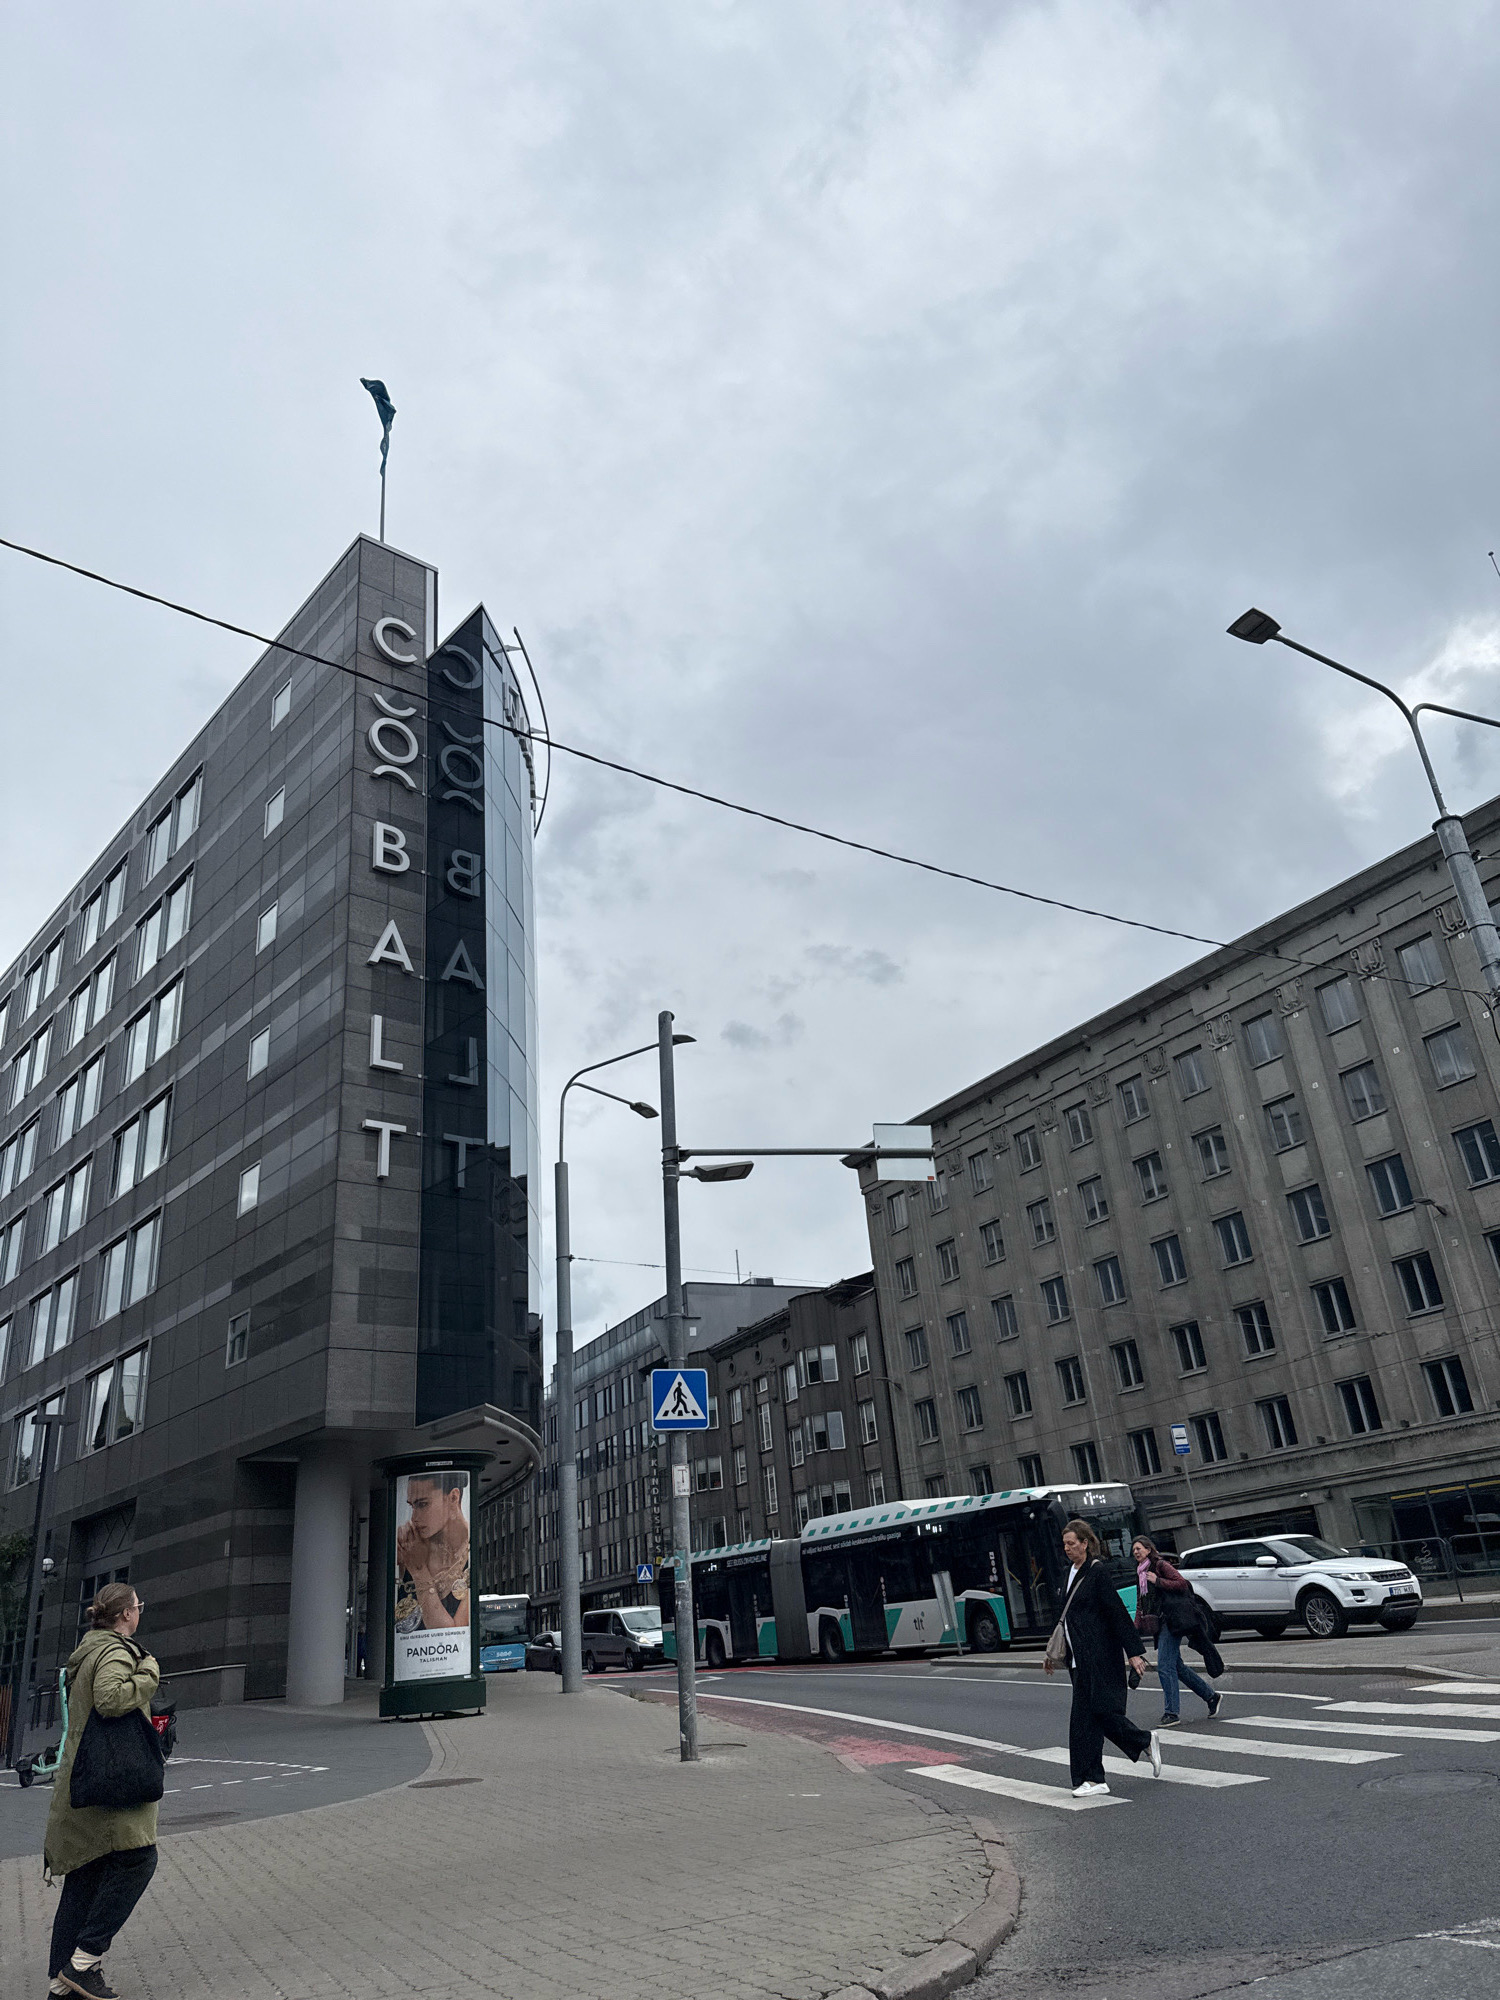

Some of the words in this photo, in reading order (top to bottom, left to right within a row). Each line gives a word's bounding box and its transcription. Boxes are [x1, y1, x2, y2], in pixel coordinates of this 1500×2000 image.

[651, 1459, 662, 1553] KINDLUSTUS
[913, 1616, 925, 1631] tlt
[406, 1642, 459, 1658] PANDORA
